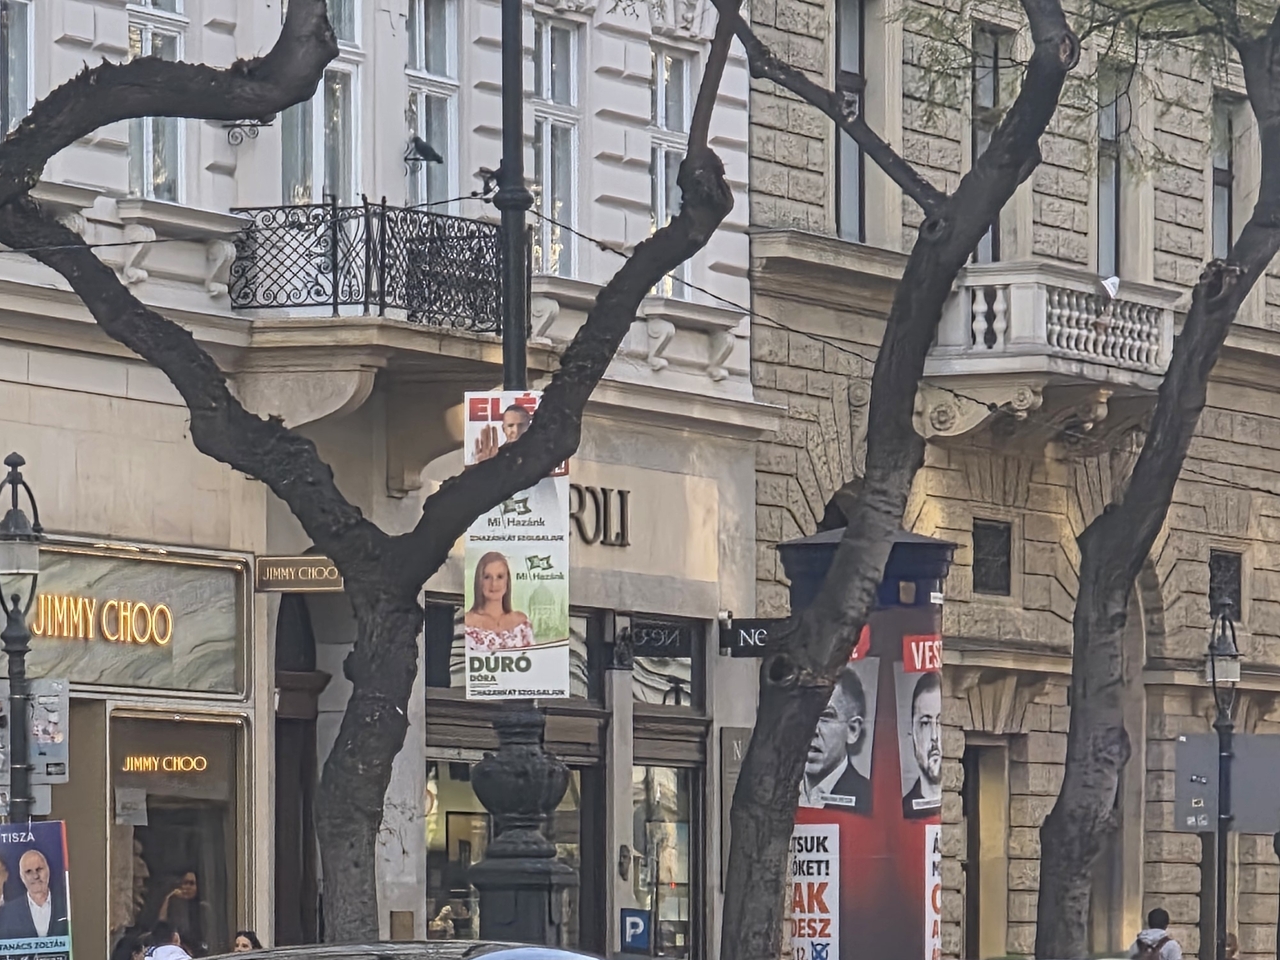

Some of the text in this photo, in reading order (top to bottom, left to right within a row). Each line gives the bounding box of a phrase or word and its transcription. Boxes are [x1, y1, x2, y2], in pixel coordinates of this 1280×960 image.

[488, 517, 501, 527] Mi
[263, 566, 339, 580] JIMMY CHOO
[32, 594, 173, 645] JIMMY CHOO
[469, 652, 532, 673] DÚRÓ
[122, 756, 207, 771] JIMMY CHOO
[1, 832, 36, 843] TISZA
[789, 836, 829, 853] TSUK
[625, 916, 645, 943] P
[34, 939, 66, 949] ZOLTÁN
